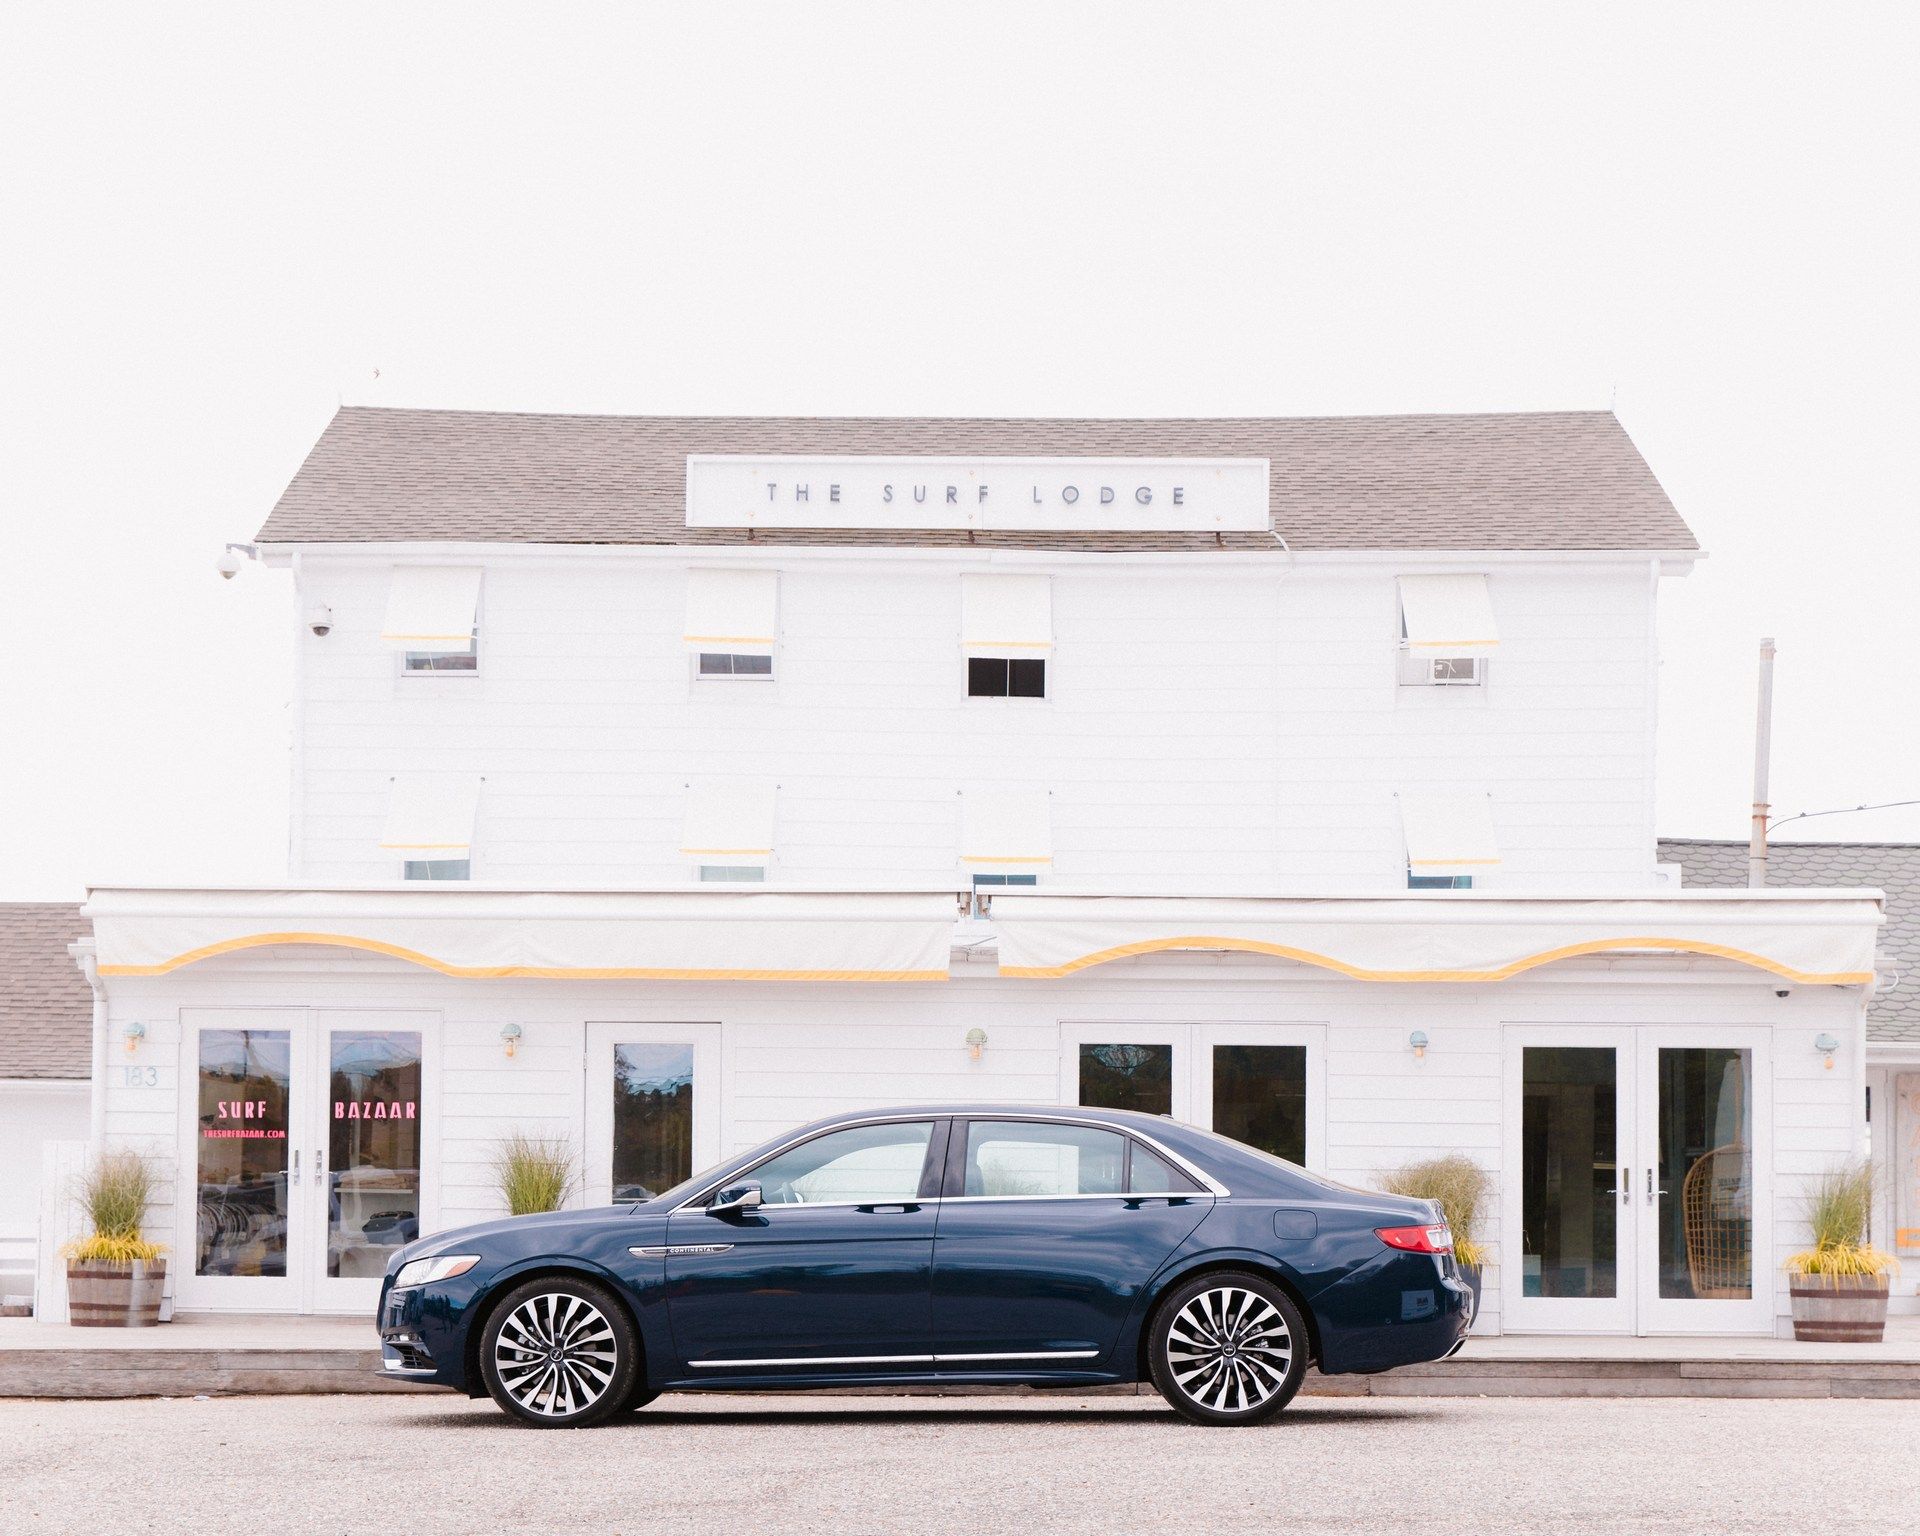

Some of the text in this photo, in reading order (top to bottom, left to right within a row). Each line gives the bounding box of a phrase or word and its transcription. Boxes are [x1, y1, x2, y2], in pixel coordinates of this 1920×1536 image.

[767, 483, 1184, 505] THE SURF LODGE
[125, 1066, 158, 1086] 183
[218, 1101, 416, 1119] SURF BAZAAR
[204, 1129, 286, 1138] THESURFBAZAAR.COM
